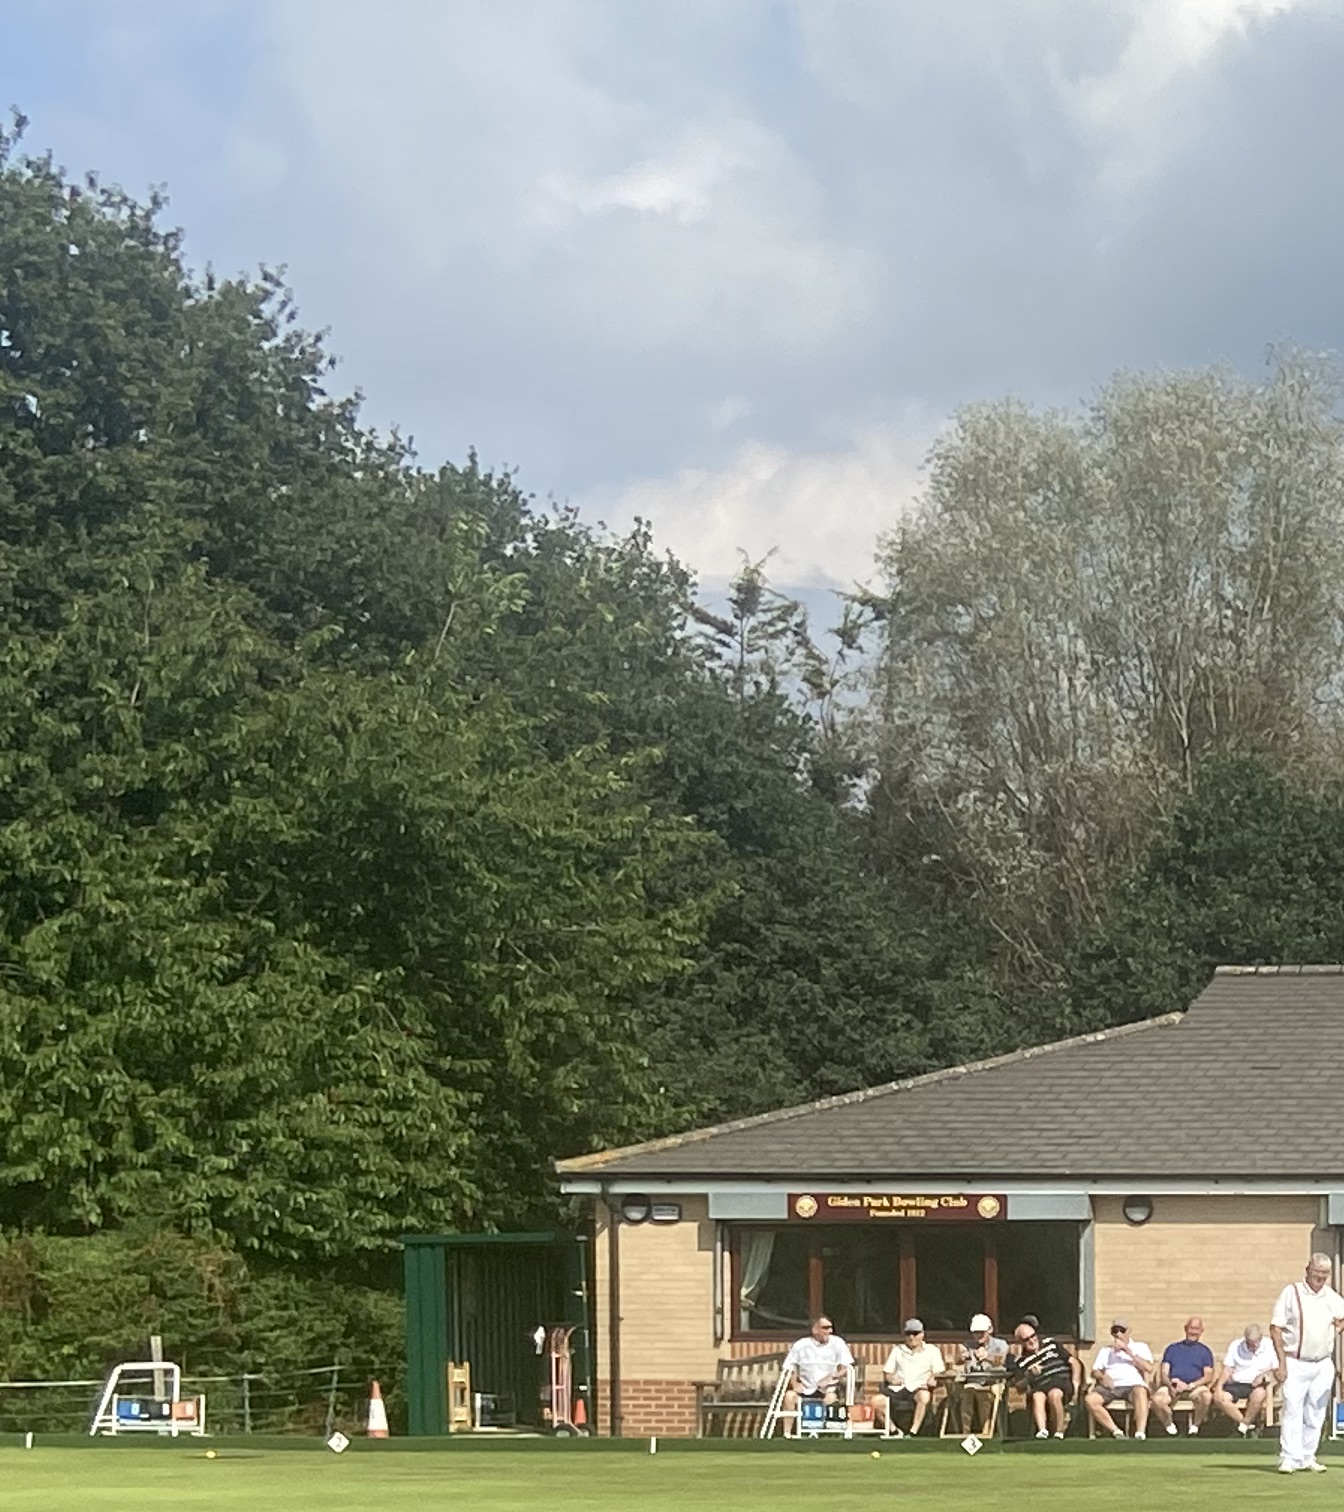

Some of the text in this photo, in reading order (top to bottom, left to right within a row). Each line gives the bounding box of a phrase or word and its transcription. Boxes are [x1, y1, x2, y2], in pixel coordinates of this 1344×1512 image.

[863, 1197, 890, 1207] Park
[892, 1197, 939, 1209] Bowling
[940, 1197, 968, 1207] Club
[870, 1209, 905, 1218] Founded
[335, 1436, 343, 1448] 2
[968, 1437, 977, 1451] 3
